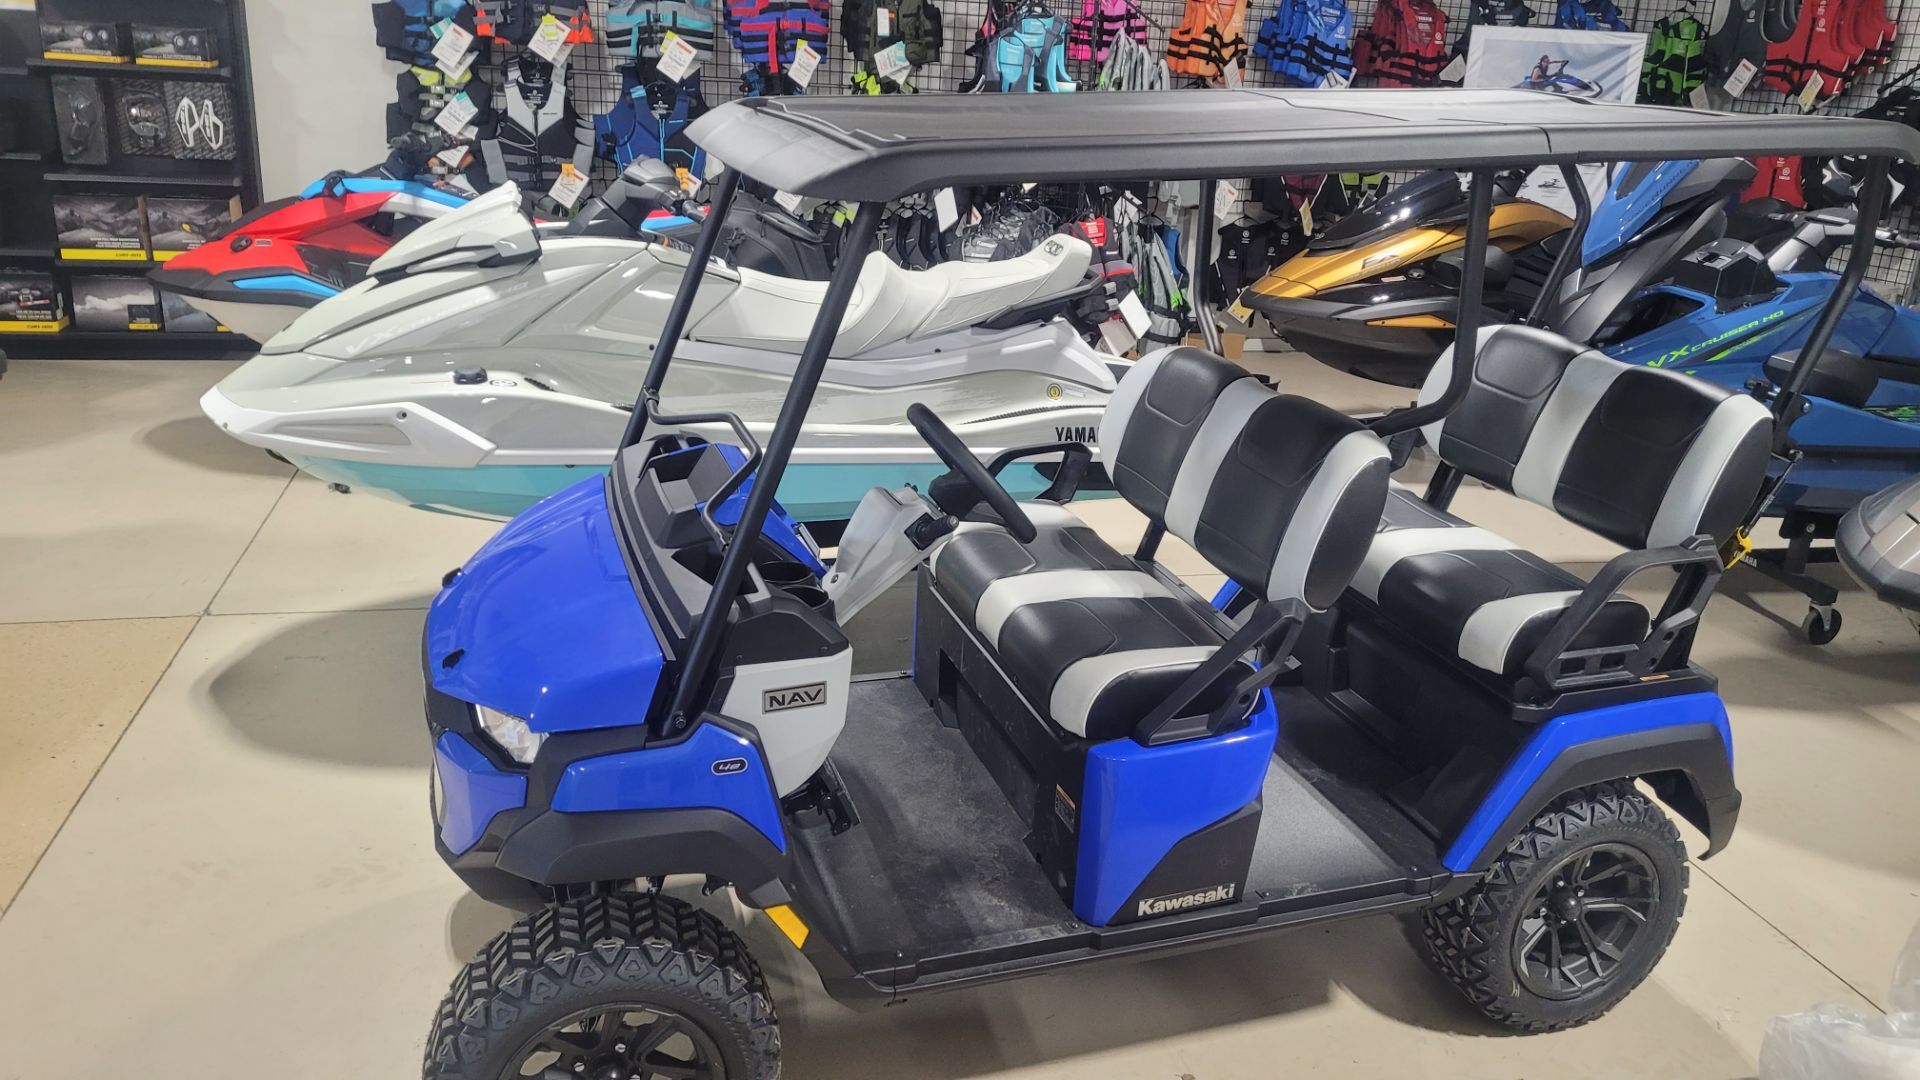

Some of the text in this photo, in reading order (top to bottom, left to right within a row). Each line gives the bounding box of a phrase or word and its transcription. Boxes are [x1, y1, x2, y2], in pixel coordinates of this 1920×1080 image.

[1647, 309, 1785, 368] VX CRUISER HO
[1055, 426, 1099, 443] YAMA
[769, 688, 822, 708] NAV
[1137, 883, 1235, 916] Kawasaki
